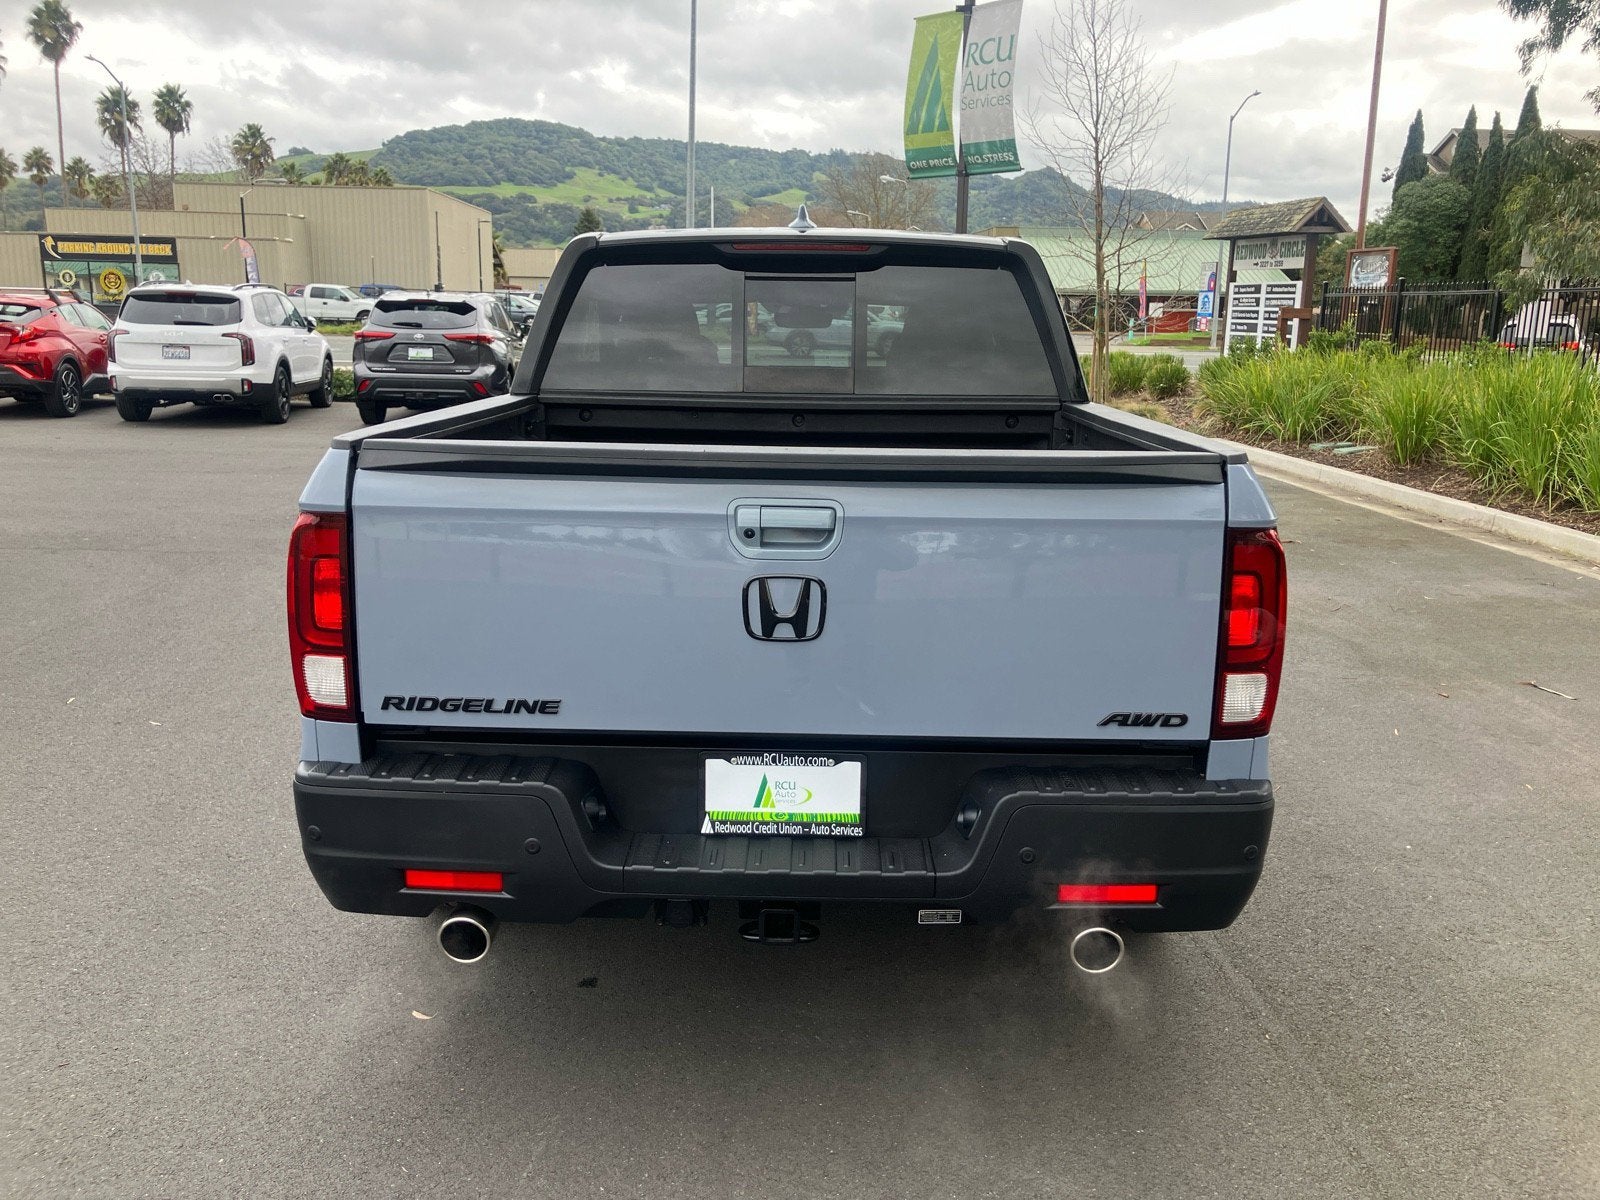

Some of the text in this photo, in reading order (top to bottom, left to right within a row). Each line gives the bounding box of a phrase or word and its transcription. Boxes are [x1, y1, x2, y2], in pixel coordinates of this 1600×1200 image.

[965, 34, 1015, 67] RCU
[962, 69, 1012, 93] Auto
[961, 94, 1011, 111] Services
[909, 157, 955, 169] ONE PRICE
[982, 152, 1015, 162] STRESS
[57, 241, 95, 254] PARKING
[95, 242, 131, 255] AROUND
[148, 243, 173, 256] BACK
[1235, 240, 1306, 260] REDWOOD CIRCLE
[380, 695, 562, 715] RIDGELINE
[1096, 711, 1189, 728] AWD
[736, 752, 828, 768] www.RCUauto.com
[774, 780, 796, 790] RCU
[774, 790, 797, 798] Auto
[714, 821, 753, 834] Redwood
[753, 821, 778, 834] Credit
[778, 822, 803, 835] Union
[810, 823, 831, 835] Auto
[831, 824, 863, 837] Services
